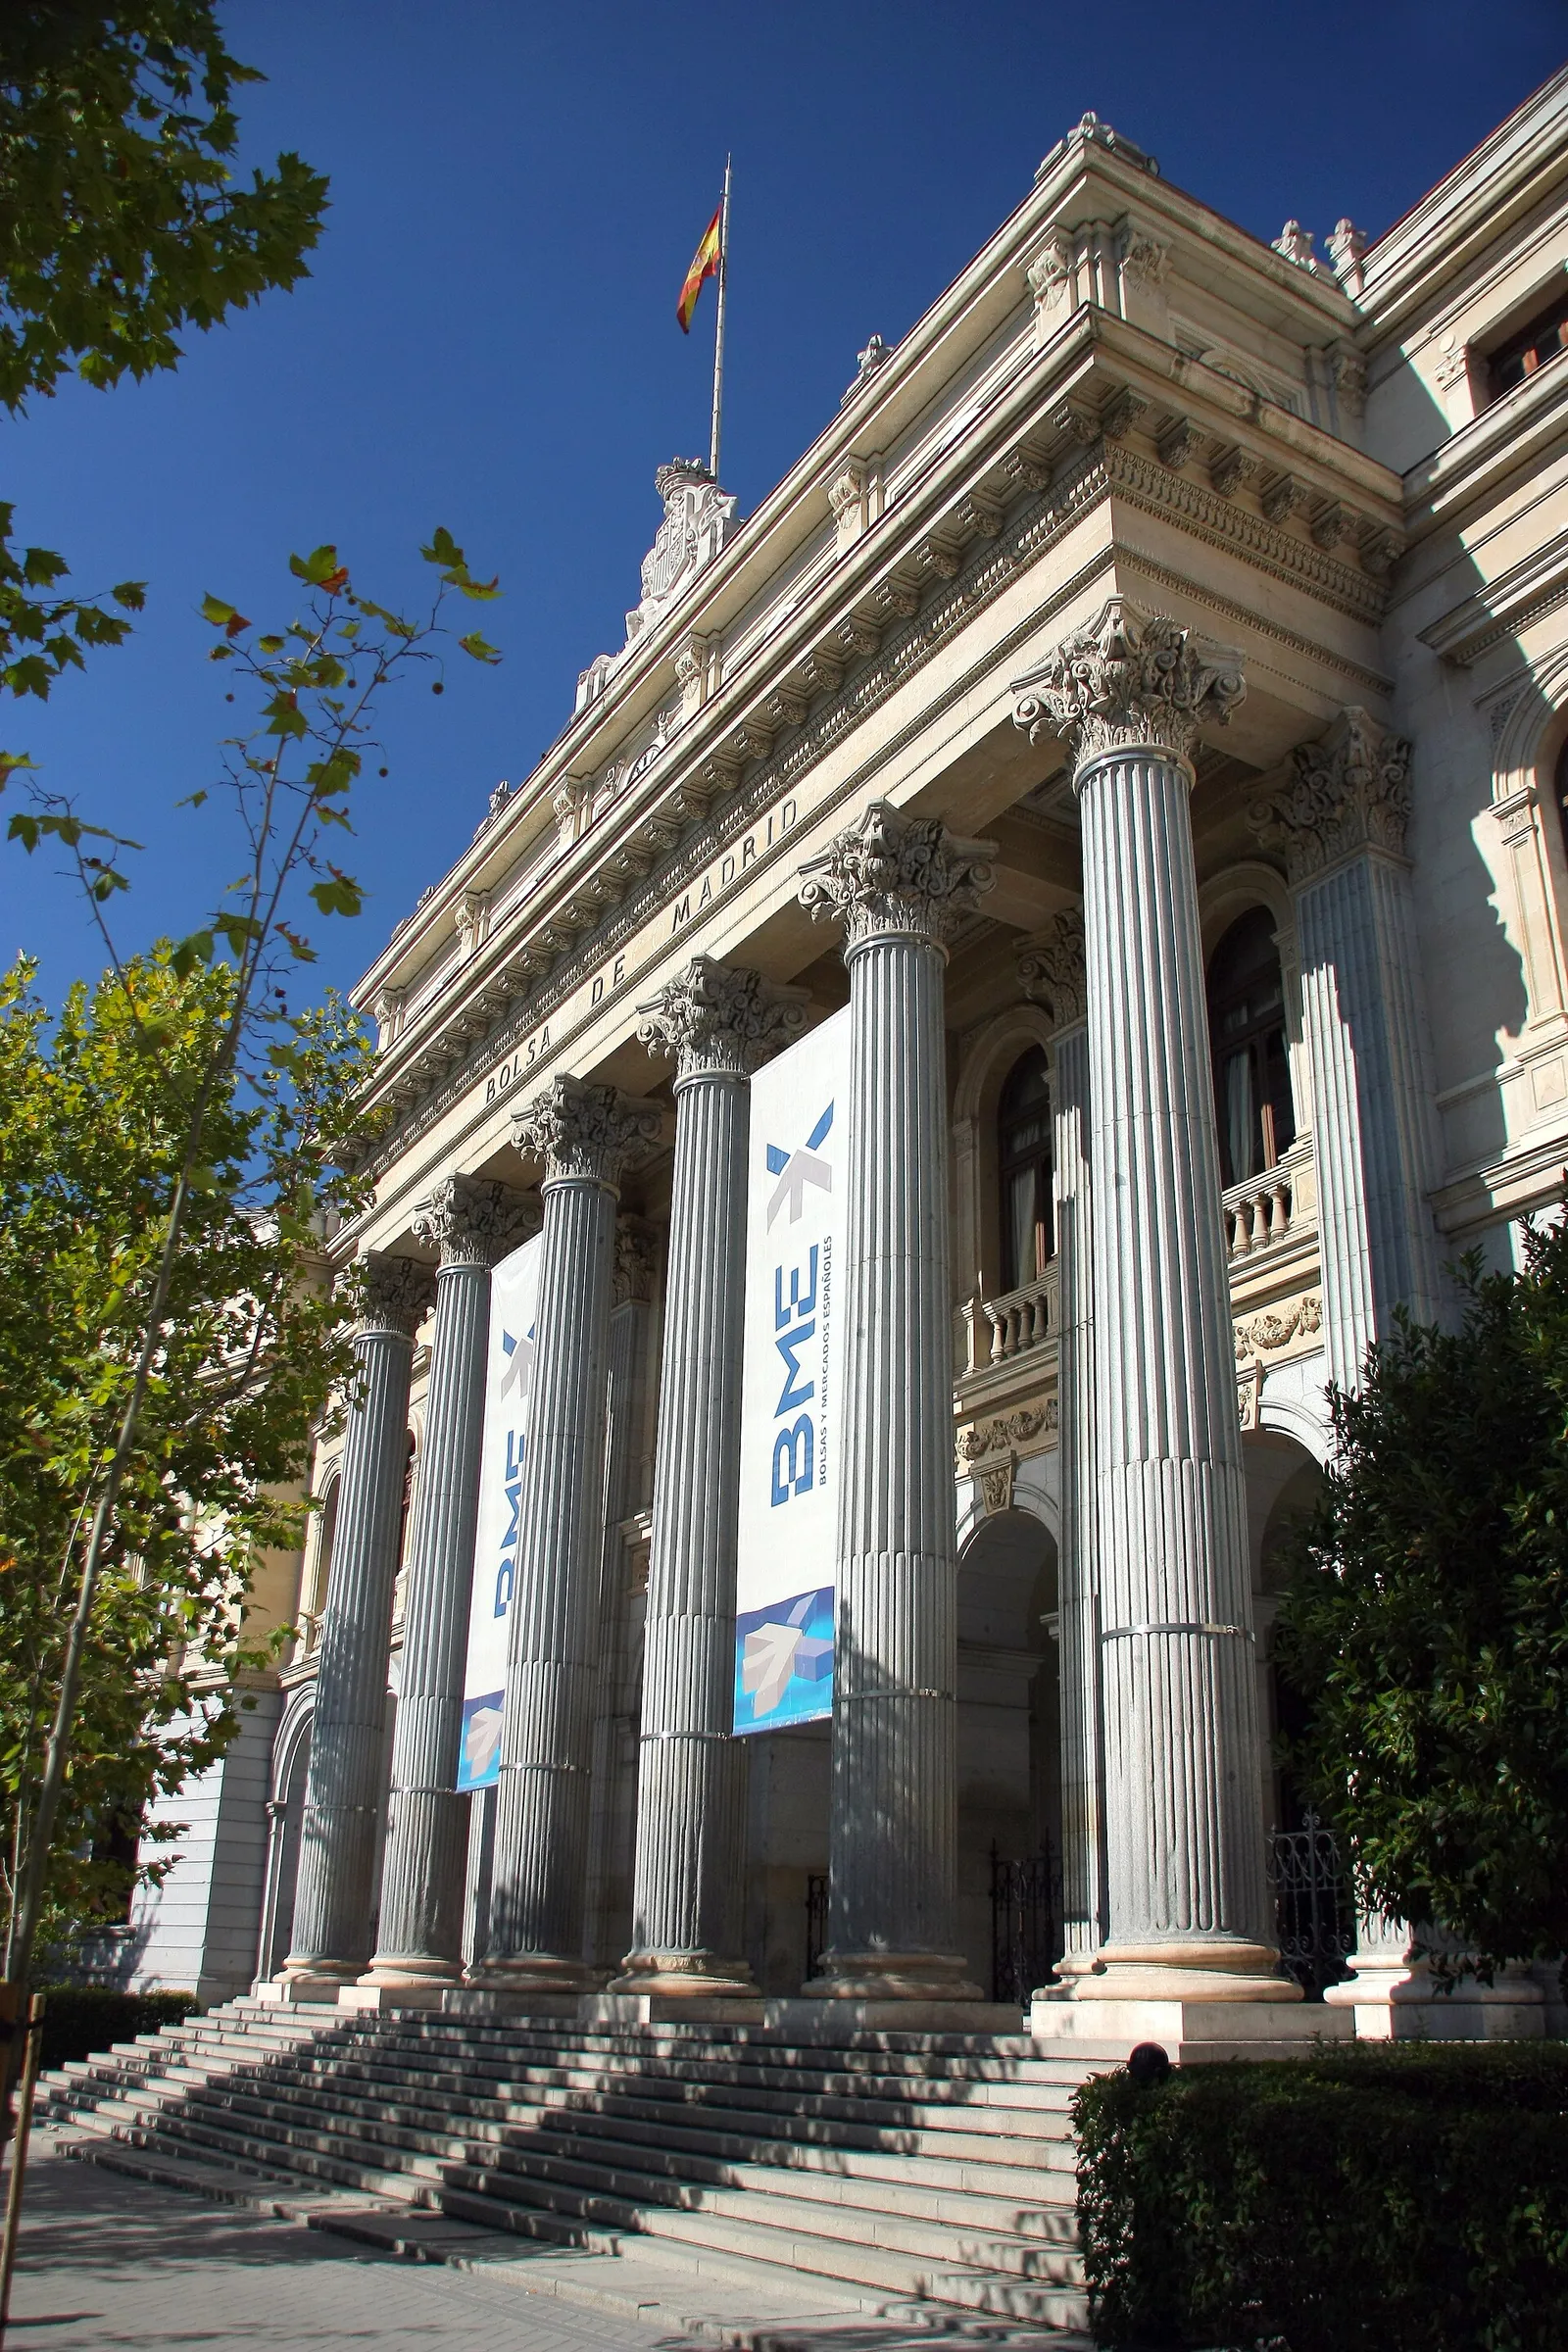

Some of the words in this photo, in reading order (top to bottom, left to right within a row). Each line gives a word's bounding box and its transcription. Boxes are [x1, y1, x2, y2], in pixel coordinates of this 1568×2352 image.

[485, 1024, 552, 1105] BOLSA
[591, 954, 626, 1007] DE
[671, 798, 798, 934] MADRID
[821, 1235, 832, 1319] ESPAÑOLES
[771, 1244, 818, 1507] BME
[821, 1322, 830, 1408] MERCADOS
[820, 1413, 827, 1422] Y
